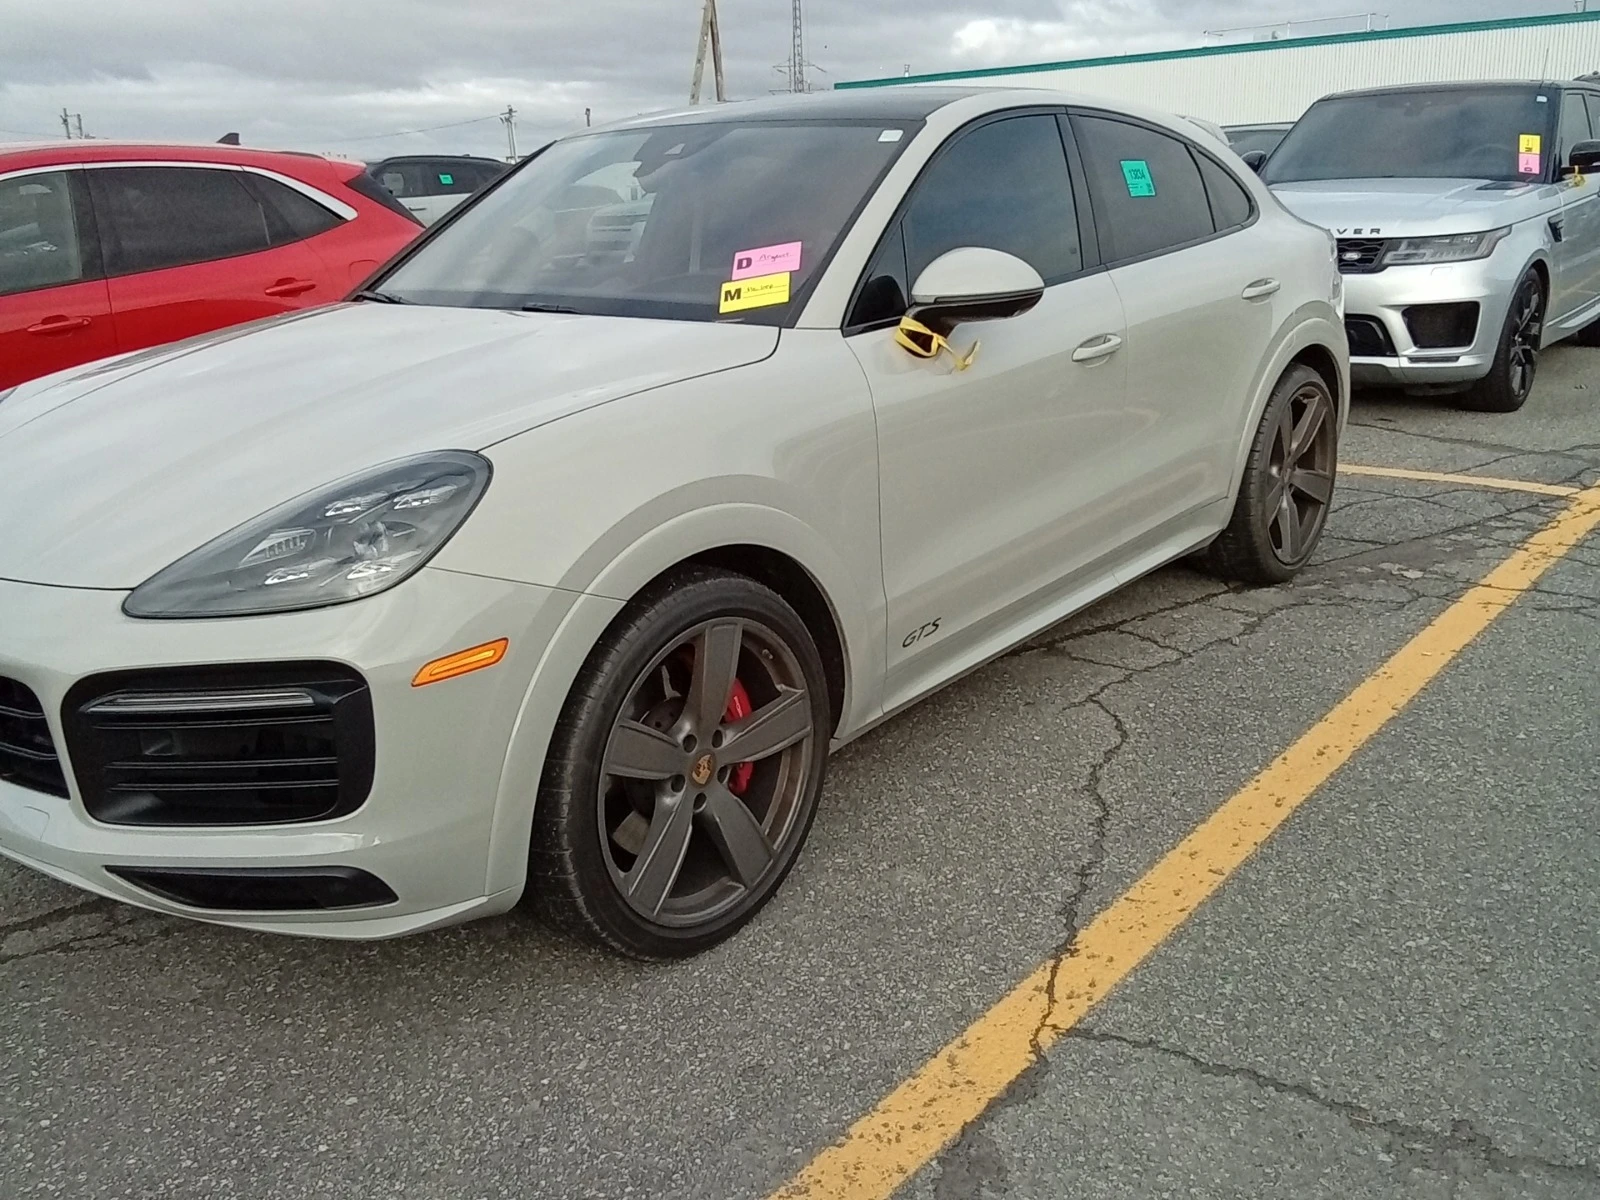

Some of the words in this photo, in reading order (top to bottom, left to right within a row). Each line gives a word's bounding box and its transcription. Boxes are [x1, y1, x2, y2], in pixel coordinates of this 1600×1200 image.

[736, 257, 753, 271] D
[723, 287, 742, 302] M
[902, 616, 942, 648] GTS
